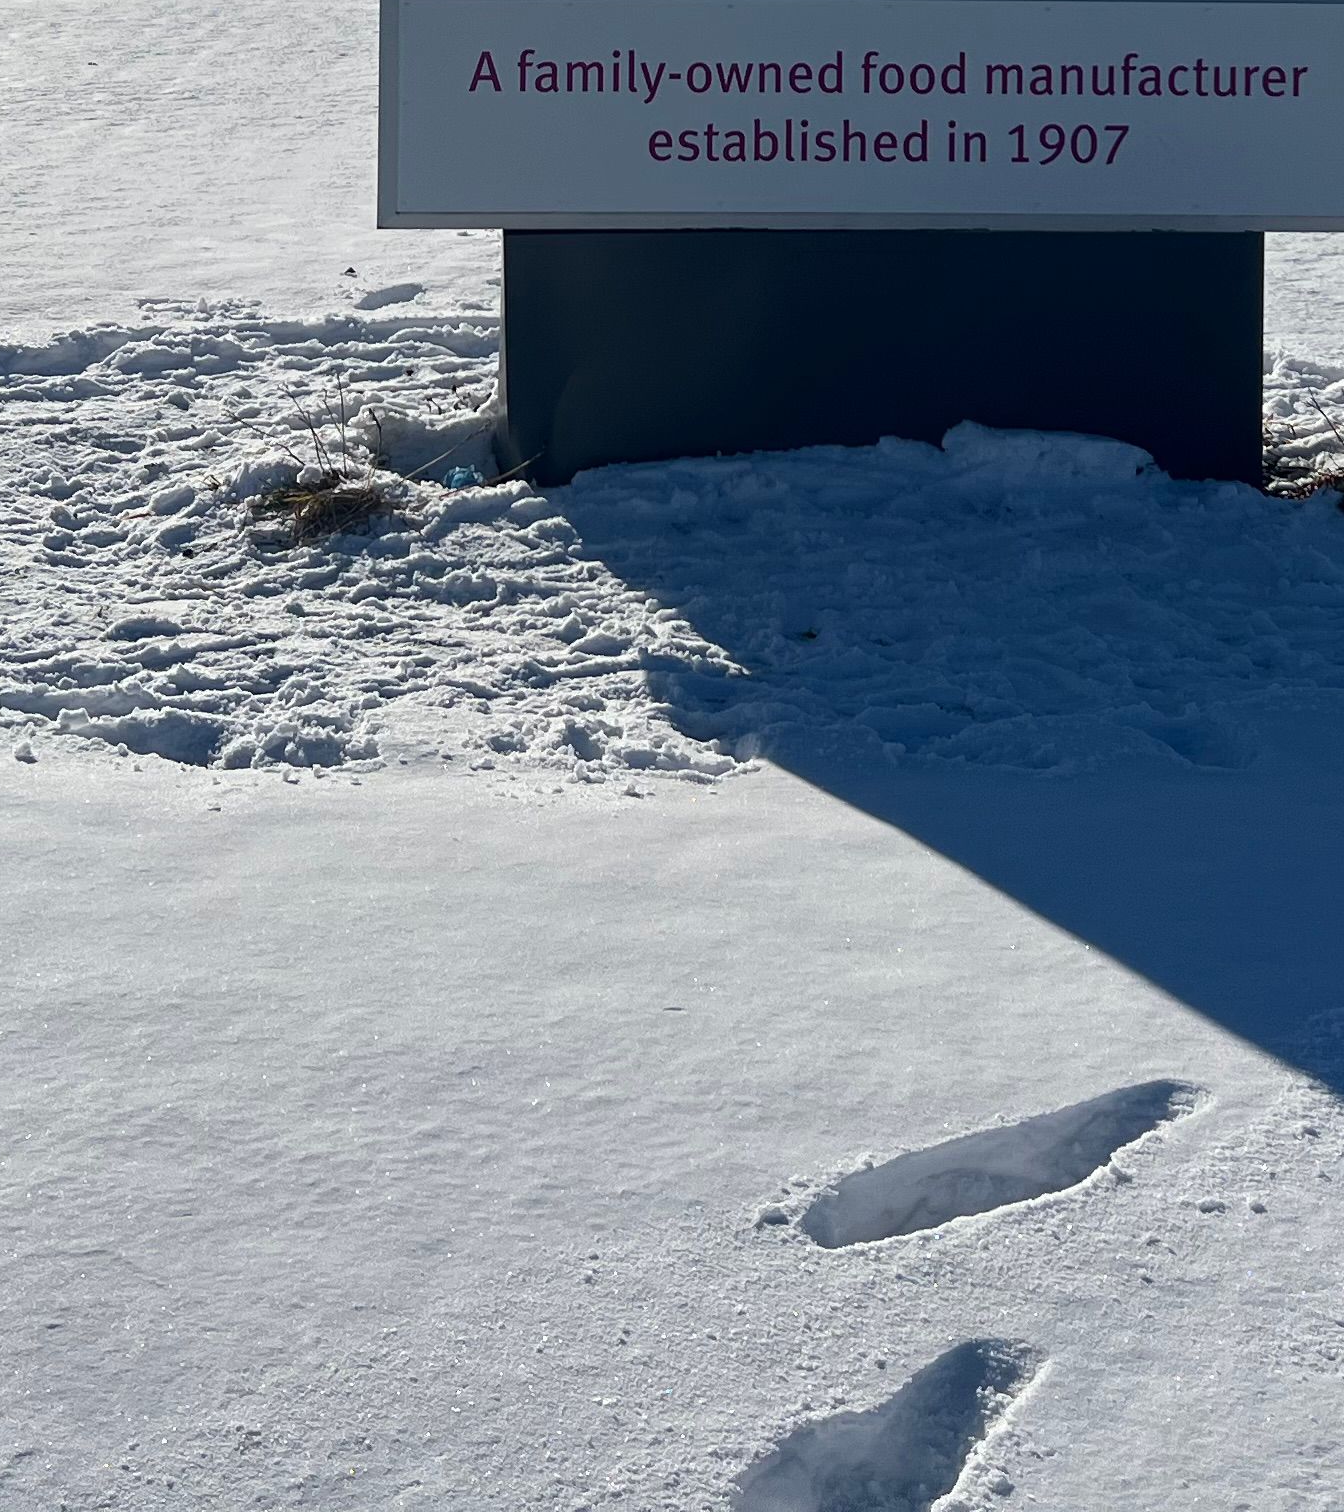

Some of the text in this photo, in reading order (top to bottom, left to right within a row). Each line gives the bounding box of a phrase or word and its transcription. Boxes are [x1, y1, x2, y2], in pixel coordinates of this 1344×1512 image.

[468, 48, 1309, 104] A family-owned food manufacturer
[647, 117, 1131, 166] established in 1907
